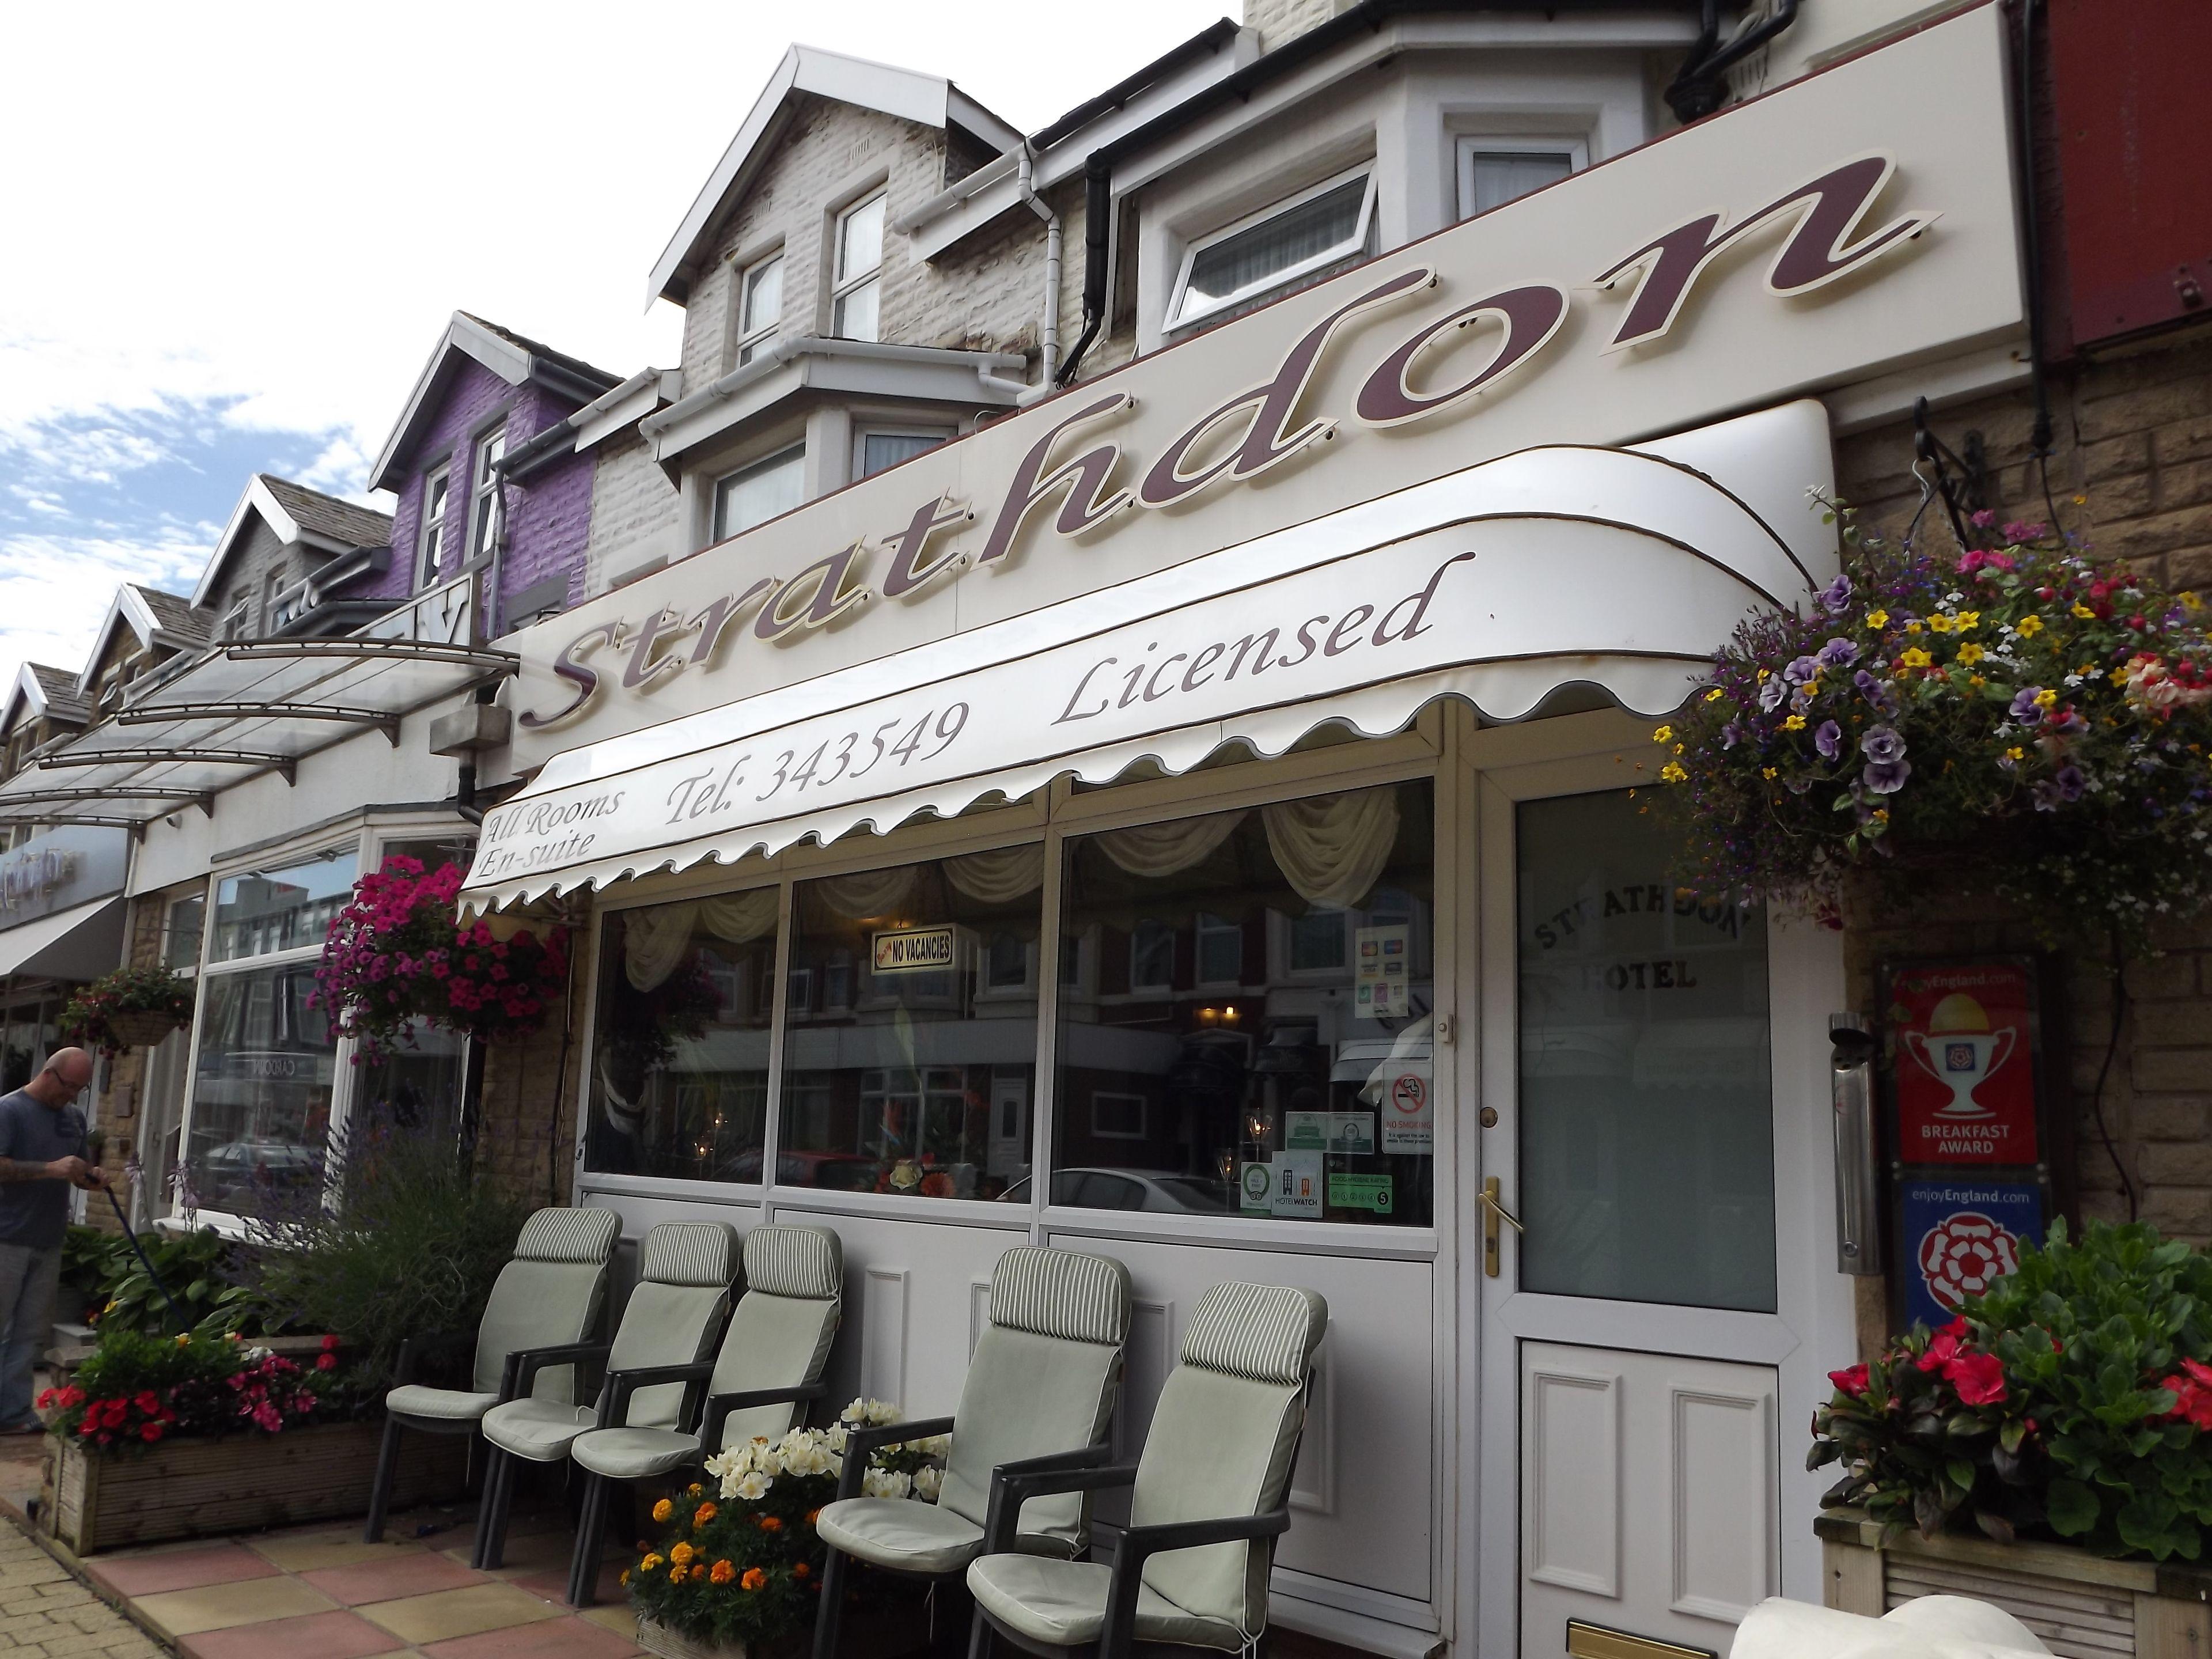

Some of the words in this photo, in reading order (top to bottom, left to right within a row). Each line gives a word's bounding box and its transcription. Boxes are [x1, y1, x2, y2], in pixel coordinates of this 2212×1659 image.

[517, 147, 1944, 731] Strathdon
[1051, 551, 1476, 726] Licensed
[665, 755, 751, 825] Tel:
[756, 702, 969, 801] 343549
[478, 803, 530, 853] All
[525, 791, 626, 835] Rooms
[476, 829, 595, 878] En-suite
[892, 939, 904, 963] NO
[906, 935, 949, 961] VACANCIES
[1901, 972, 2016, 989] yEngland.com
[1387, 1120, 1397, 1128] NO
[1399, 1120, 1432, 1129] SMOKING
[1921, 1125, 2009, 1138] BREAKFAST
[1938, 1141, 1994, 1153] AWARD
[1380, 1194, 1386, 1203] 5
[1912, 1188, 2029, 1204] enjoyEngland.com
